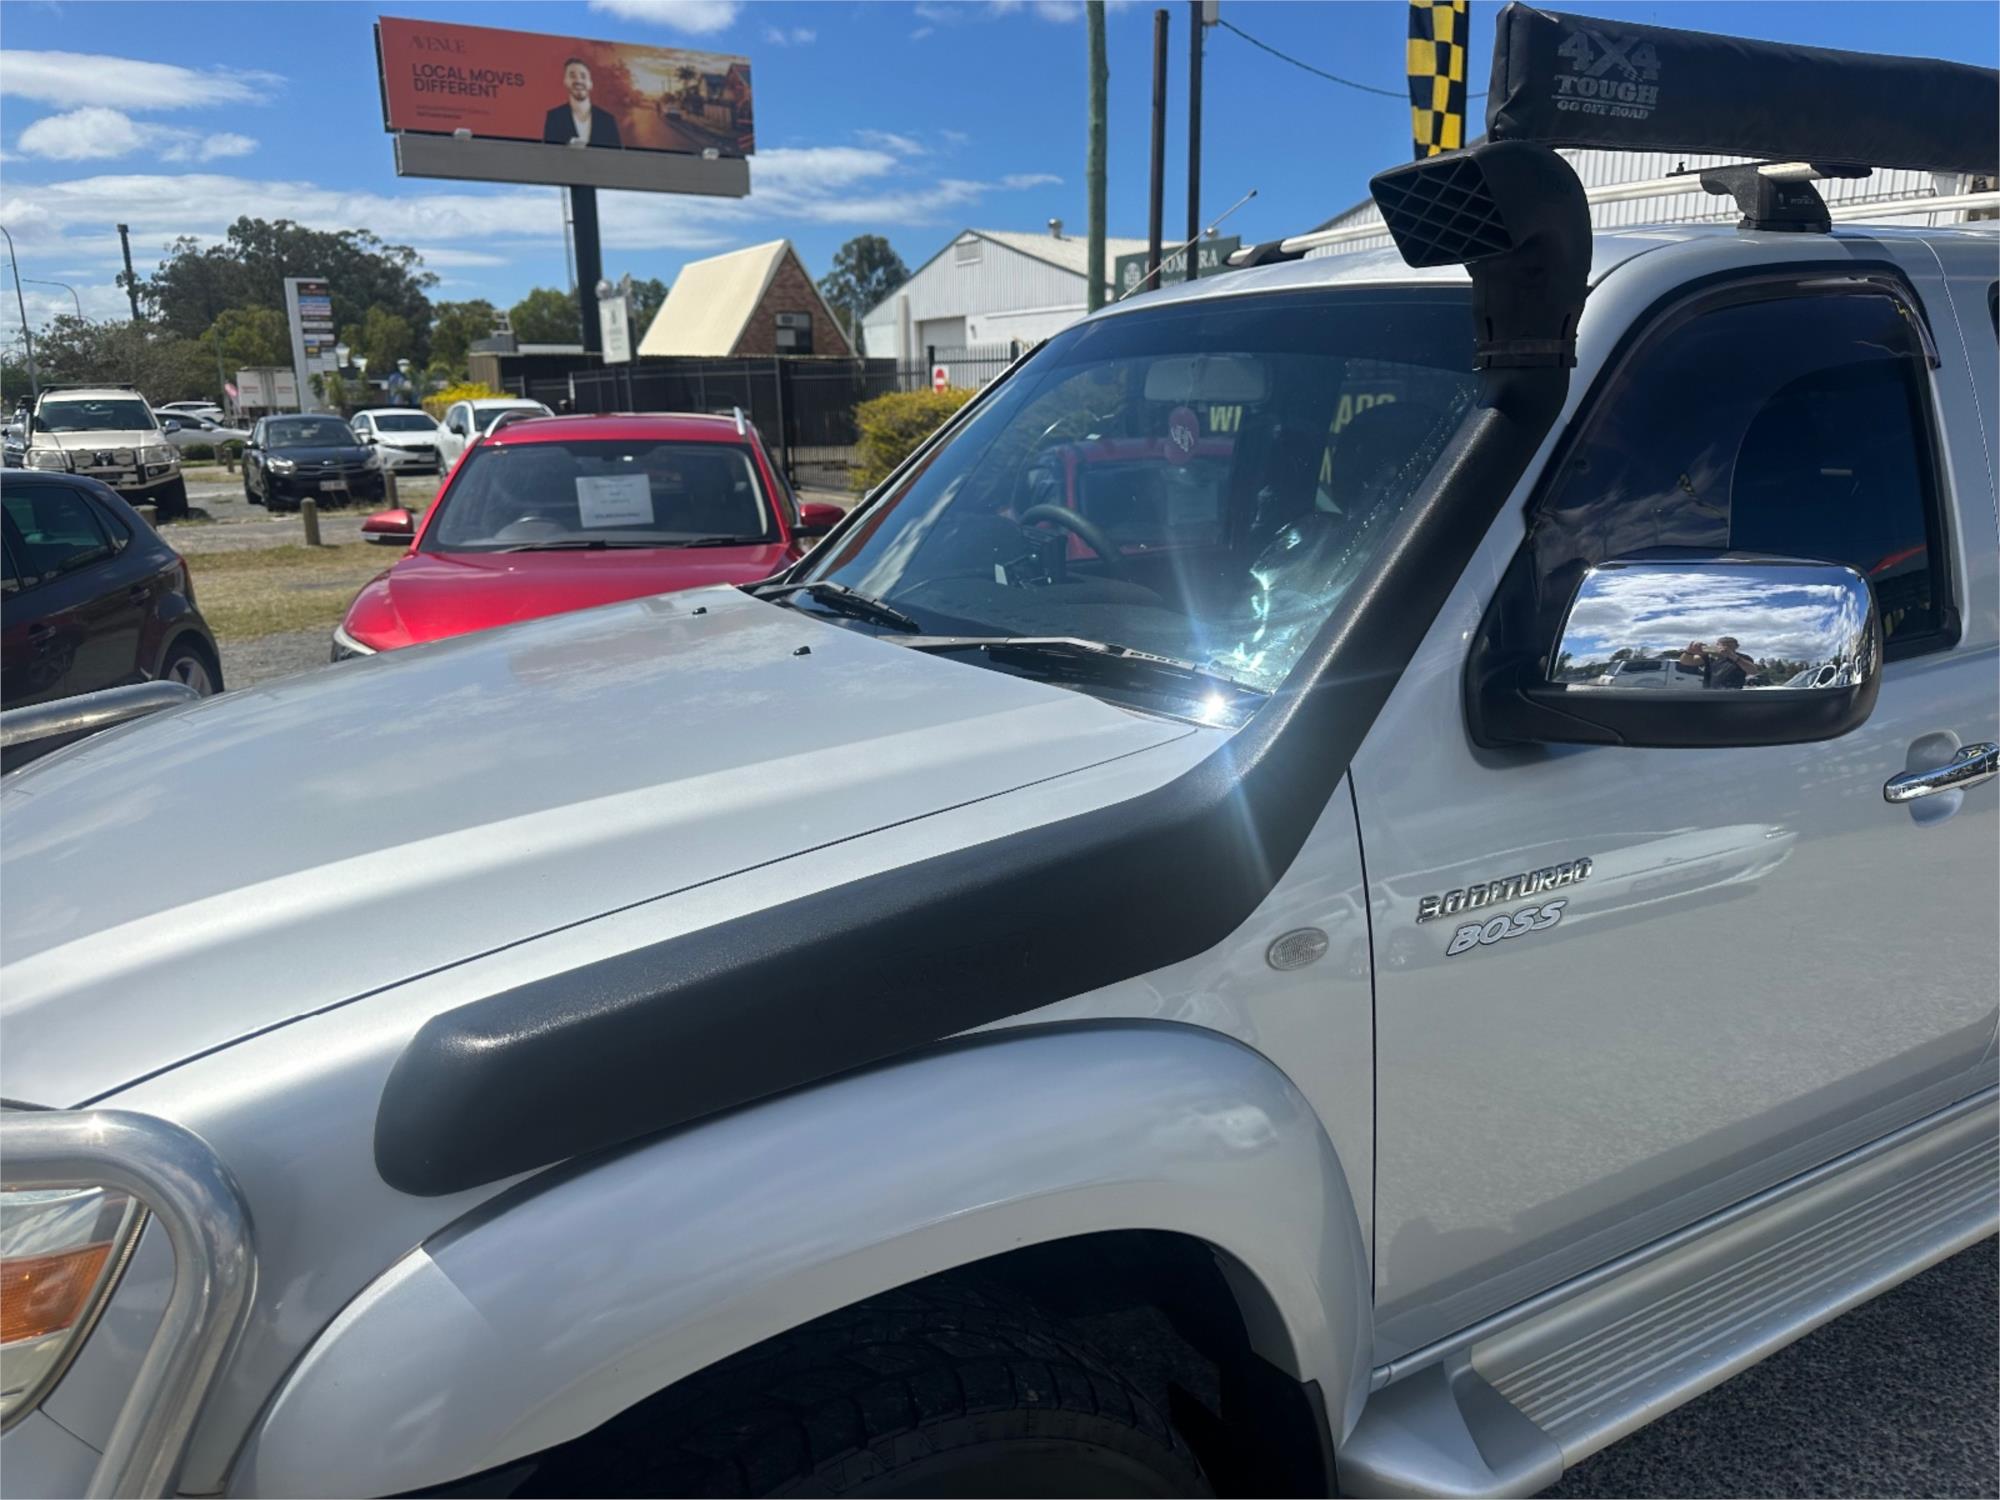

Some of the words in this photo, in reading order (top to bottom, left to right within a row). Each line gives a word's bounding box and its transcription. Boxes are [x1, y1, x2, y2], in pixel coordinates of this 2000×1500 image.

[412, 63, 466, 81] LOCAL
[469, 69, 524, 87] MOVES
[413, 78, 499, 99] DIFFERENT
[1554, 74, 1659, 104] TOUGH
[1557, 100, 1580, 111] GO
[1582, 103, 1609, 116] OFF
[1610, 105, 1649, 120] ROAD
[1446, 898, 1568, 956] BOSS
